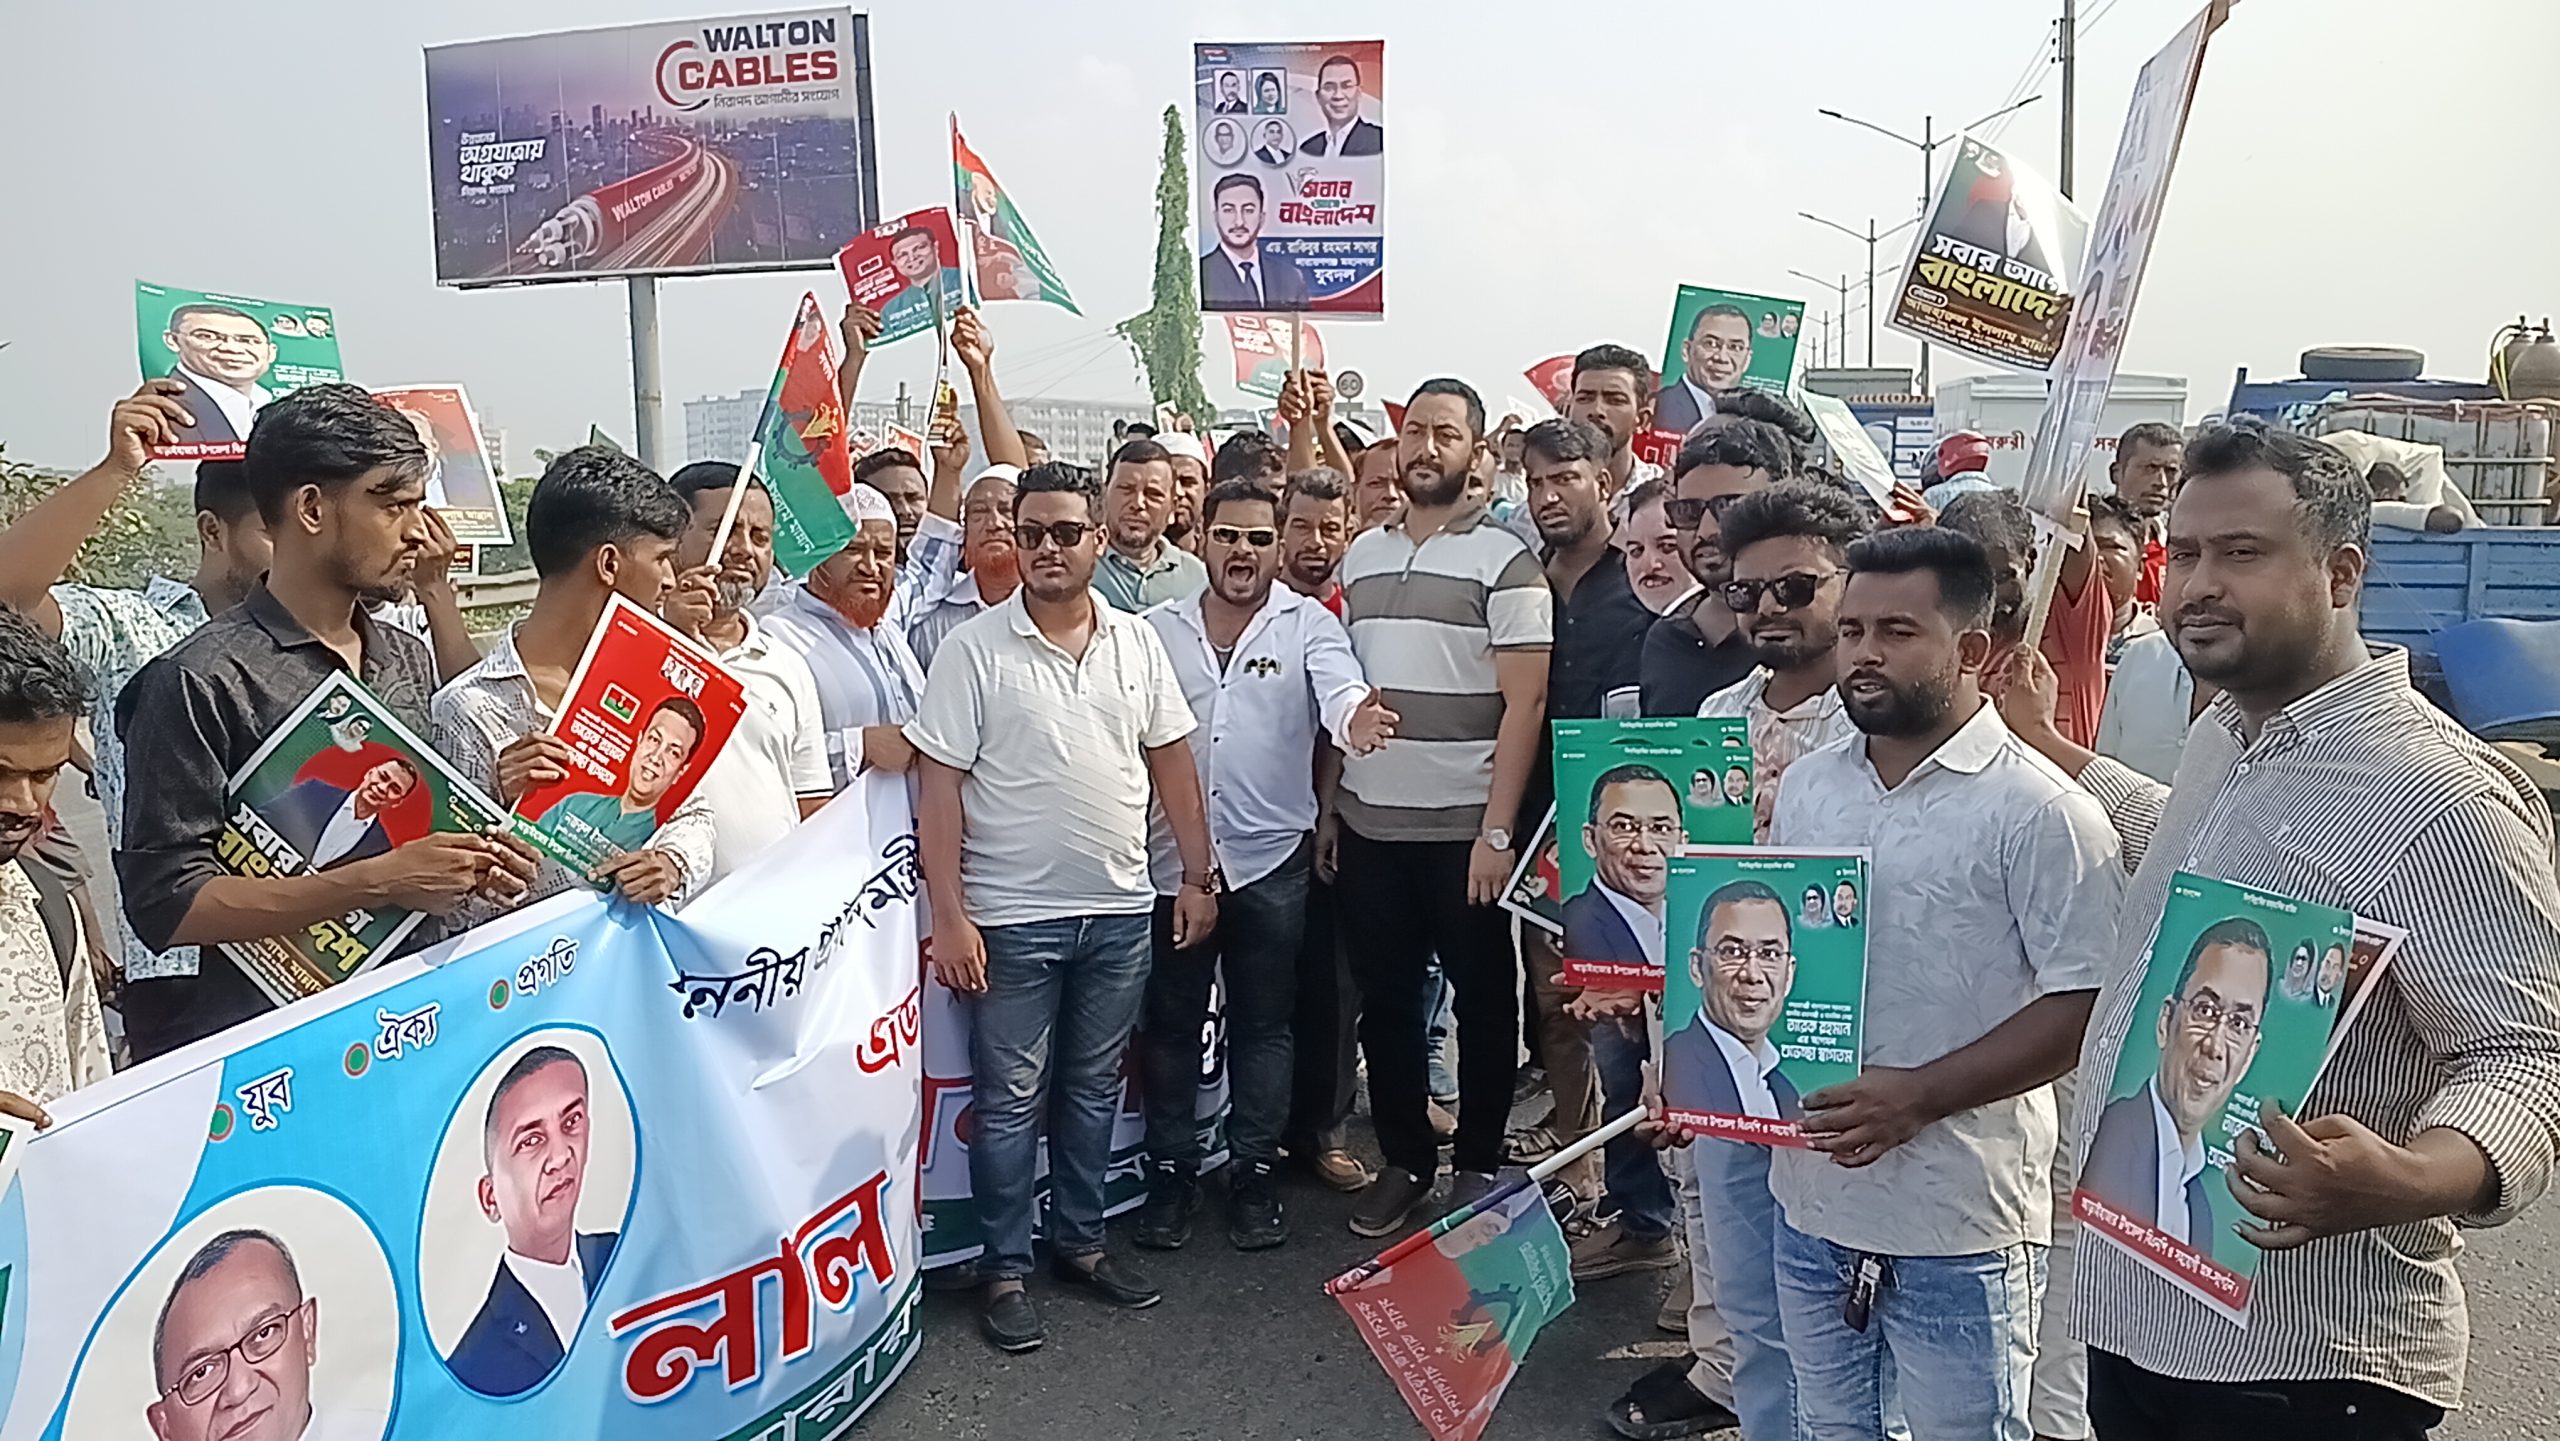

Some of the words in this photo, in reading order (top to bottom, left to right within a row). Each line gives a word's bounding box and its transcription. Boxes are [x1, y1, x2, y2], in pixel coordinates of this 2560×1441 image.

[703, 18, 836, 52] WALTON
[678, 50, 838, 91] CABLES
[460, 139, 546, 164] অগ্রযাত্রায়
[460, 161, 517, 185] থাকুক
[611, 189, 653, 222] WALTON
[1279, 202, 1376, 226] বাংলাদেশ
[1932, 233, 2001, 274] সবার
[1313, 269, 1356, 286] যুবদল
[225, 801, 306, 876] সবার
[516, 938, 579, 995] প্রগতি
[377, 1003, 440, 1058] ঐক্য
[1786, 1019, 1817, 1034] তারেক
[1819, 1021, 1851, 1036] রহমান
[241, 1070, 292, 1128] যুব
[609, 1170, 894, 1400] লাল
